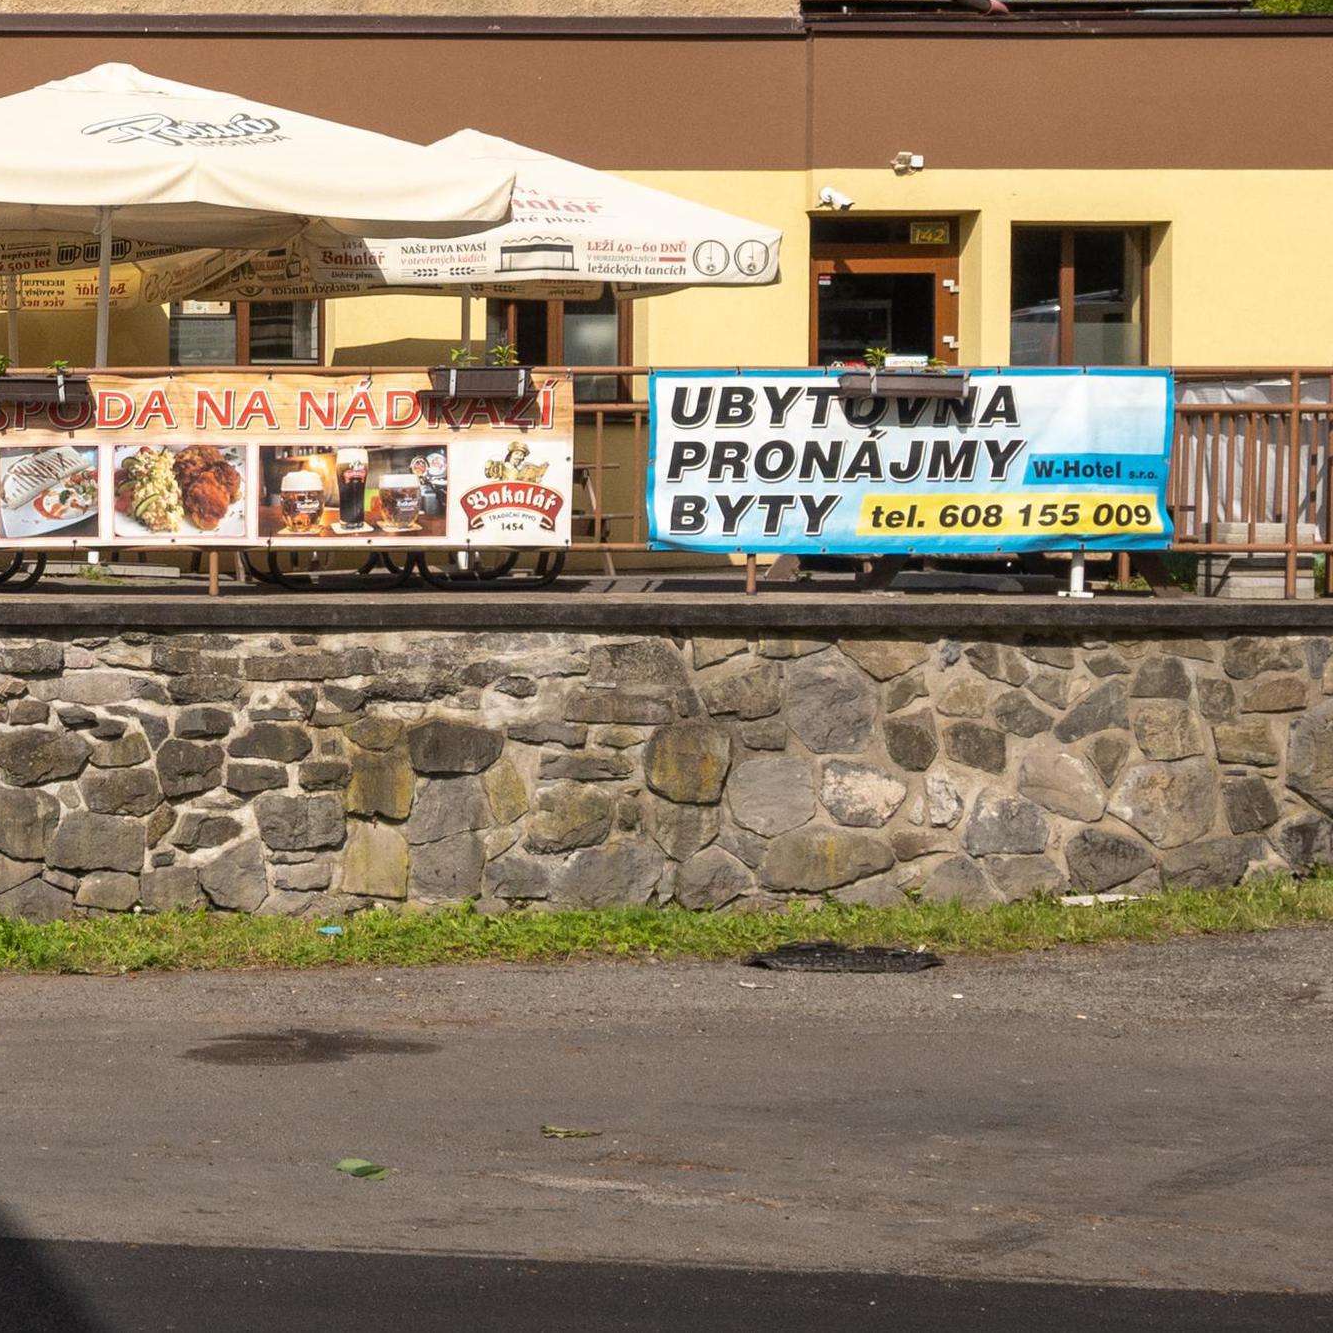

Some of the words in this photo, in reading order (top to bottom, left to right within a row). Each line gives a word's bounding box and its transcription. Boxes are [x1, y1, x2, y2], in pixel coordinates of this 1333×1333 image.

[915, 229, 945, 242] 142
[401, 243, 428, 254] NAŠE
[430, 245, 454, 253] PIVA
[456, 242, 486, 252] KVASÍ
[587, 240, 614, 252] LEŽÍ
[660, 239, 686, 252] DNŮ
[321, 250, 385, 265] Bakalář
[7, 262, 30, 273] 500
[34, 259, 50, 268] let
[587, 262, 641, 277] ležáckých
[645, 263, 686, 275] tancích
[195, 388, 278, 429] NA
[670, 385, 1023, 429] UBYTOVNA
[666, 430, 1027, 483] PRONÁJMY
[1033, 460, 1121, 479] W-Hotel
[1129, 470, 1158, 480] s.r.o.
[467, 485, 557, 510] Bakalář
[489, 511, 520, 522] TRADIČNÍ
[669, 495, 842, 536] BYTY
[872, 505, 925, 528] tel.
[939, 504, 1003, 528] 608
[1018, 504, 1080, 526] 155
[1093, 503, 1151, 527] 009
[501, 523, 524, 531] 1454
